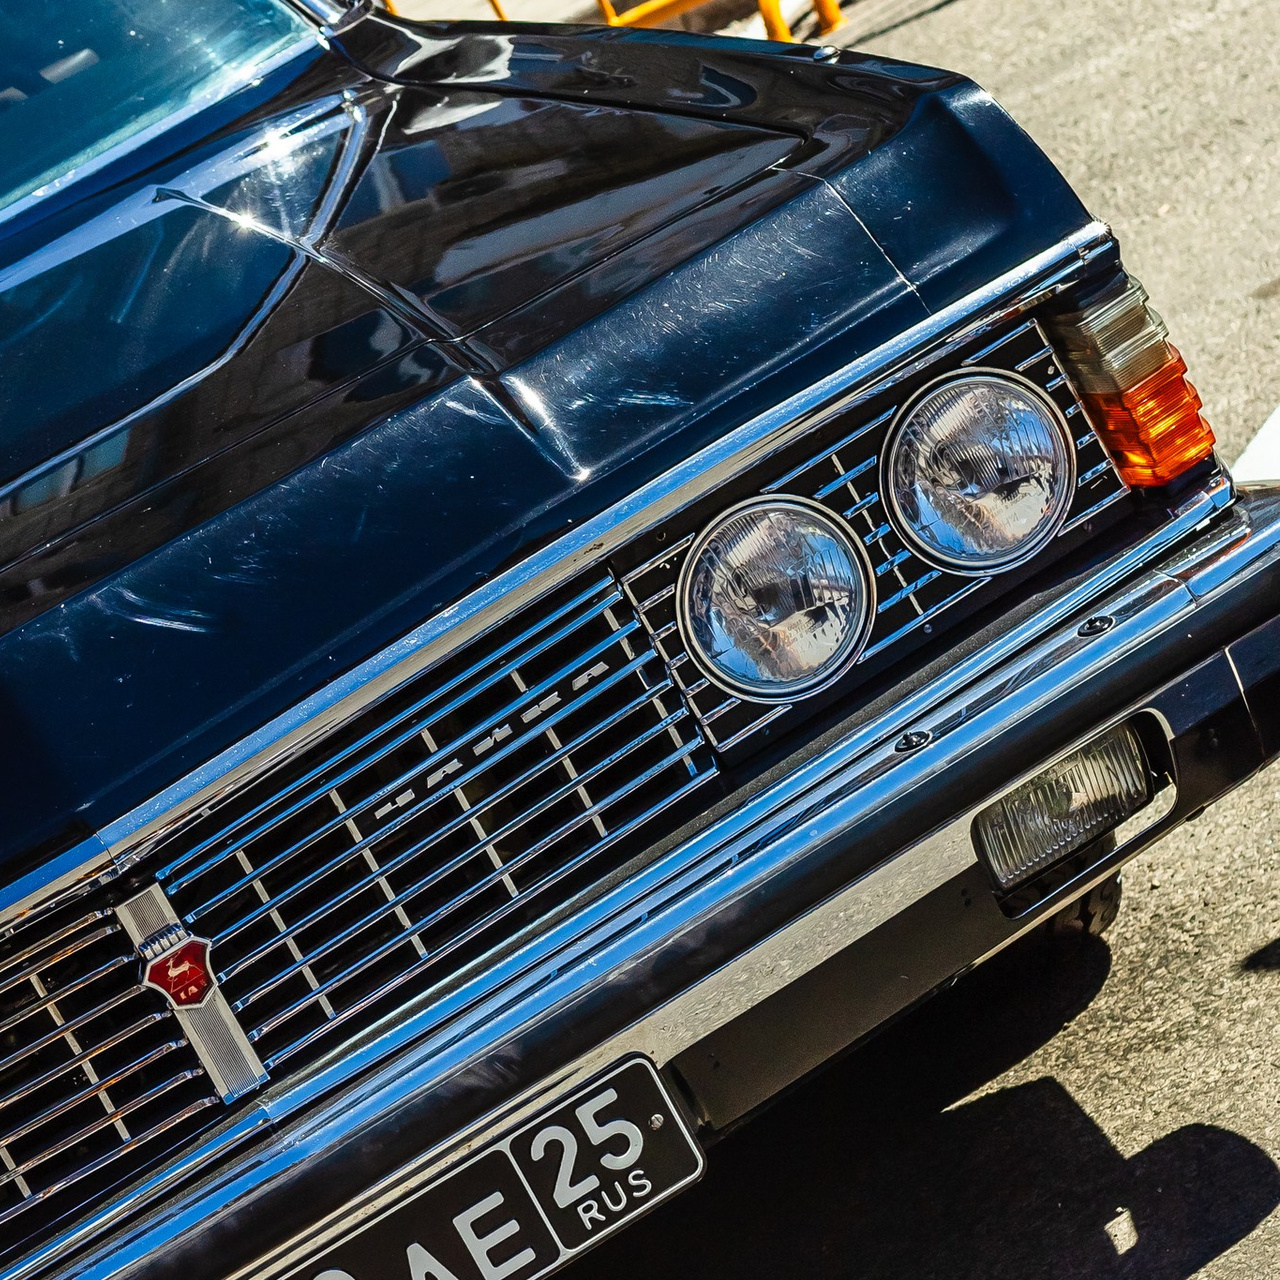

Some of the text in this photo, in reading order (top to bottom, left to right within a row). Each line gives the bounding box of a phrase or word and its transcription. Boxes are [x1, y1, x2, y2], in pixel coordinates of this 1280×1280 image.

[373, 660, 610, 820] ЧАЙКА
[530, 1088, 644, 1208] 25
[577, 1169, 652, 1230] RUS
